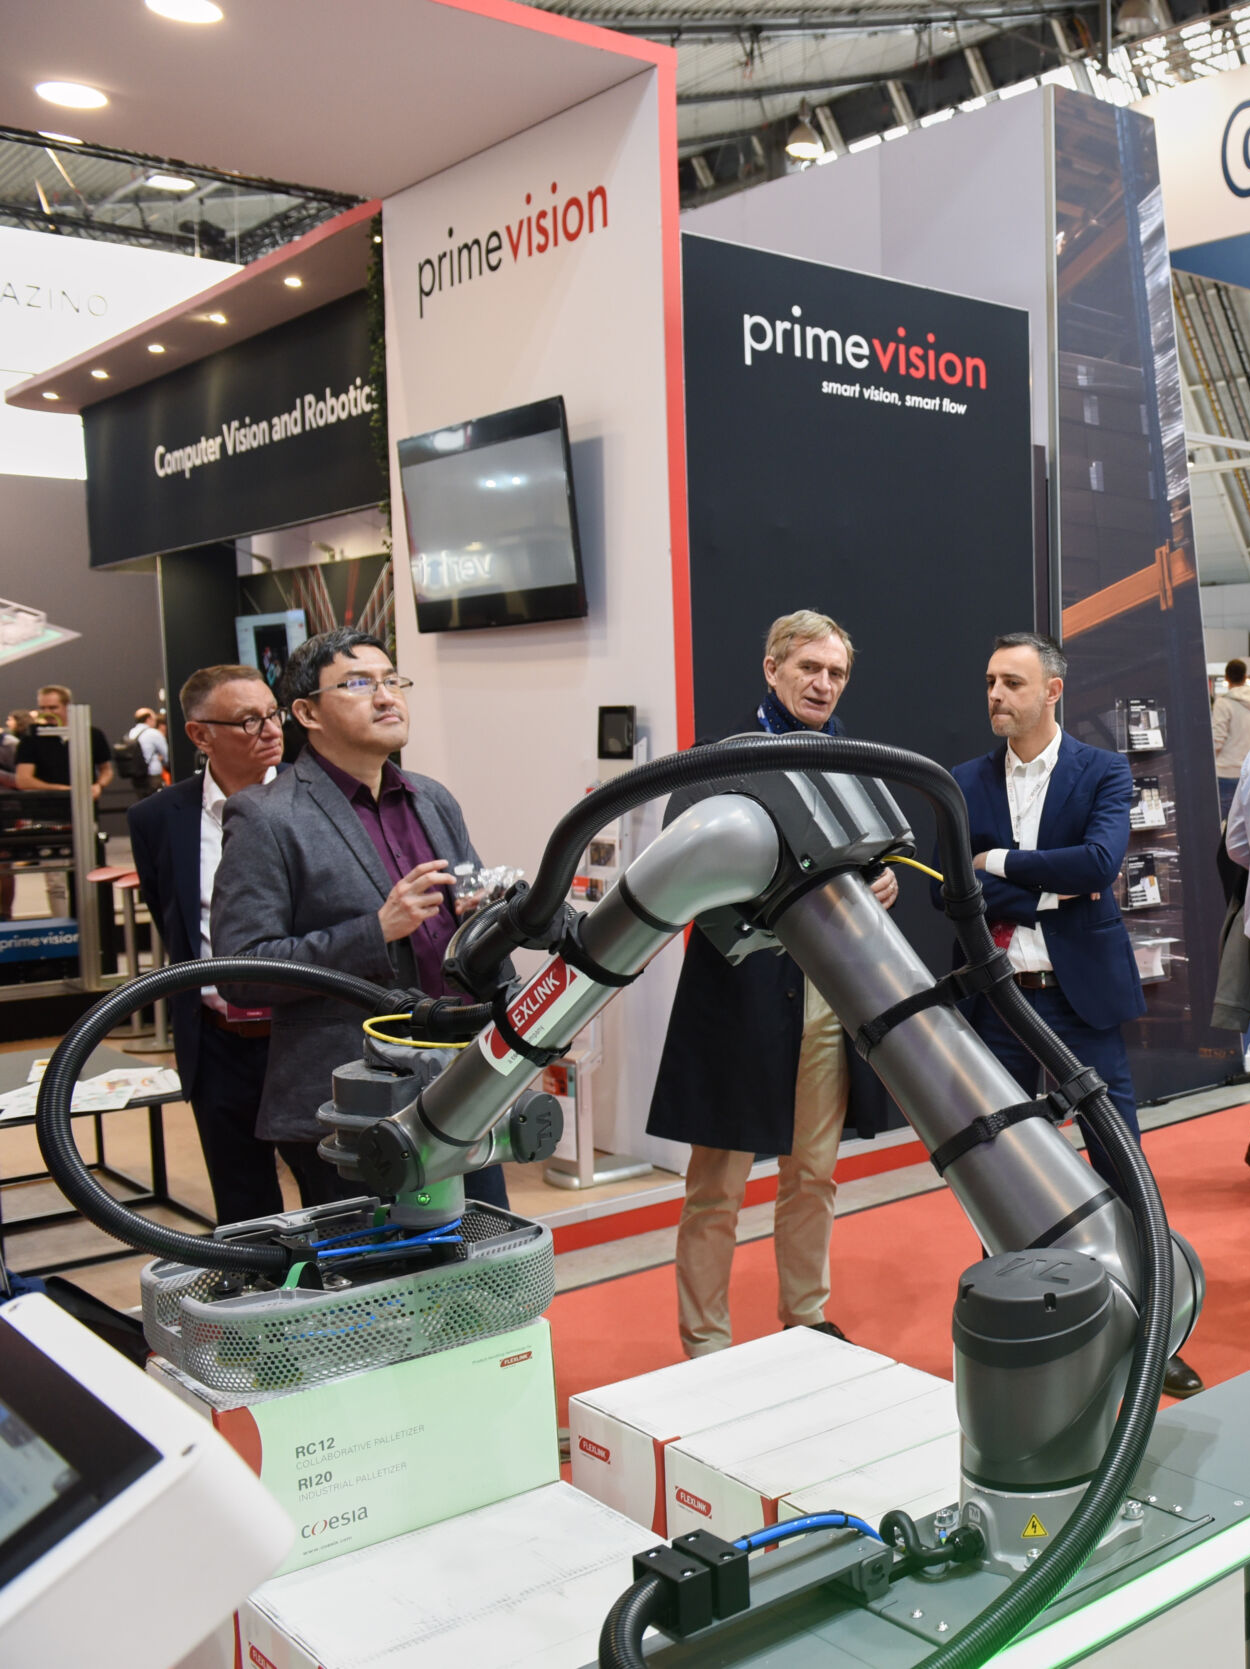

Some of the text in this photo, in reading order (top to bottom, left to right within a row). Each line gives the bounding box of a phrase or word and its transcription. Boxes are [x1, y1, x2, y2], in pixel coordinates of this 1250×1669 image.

[418, 181, 608, 319] primevision
[743, 304, 988, 390] primevision
[821, 380, 968, 415] smart vision, smart flow
[154, 435, 223, 479] Computer
[222, 416, 270, 456] Vision
[271, 397, 303, 442] and
[511, 971, 561, 1032] EXLINK
[295, 1437, 336, 1459] RC12
[296, 1424, 425, 1470] COLLABORATIVE PALLETIZER
[582, 1441, 607, 1459] FLEXLINK
[298, 1471, 333, 1492] RI20
[298, 1461, 408, 1503] INDUSTRIAL PALLETIZER
[680, 1491, 707, 1513] FLEXLINK
